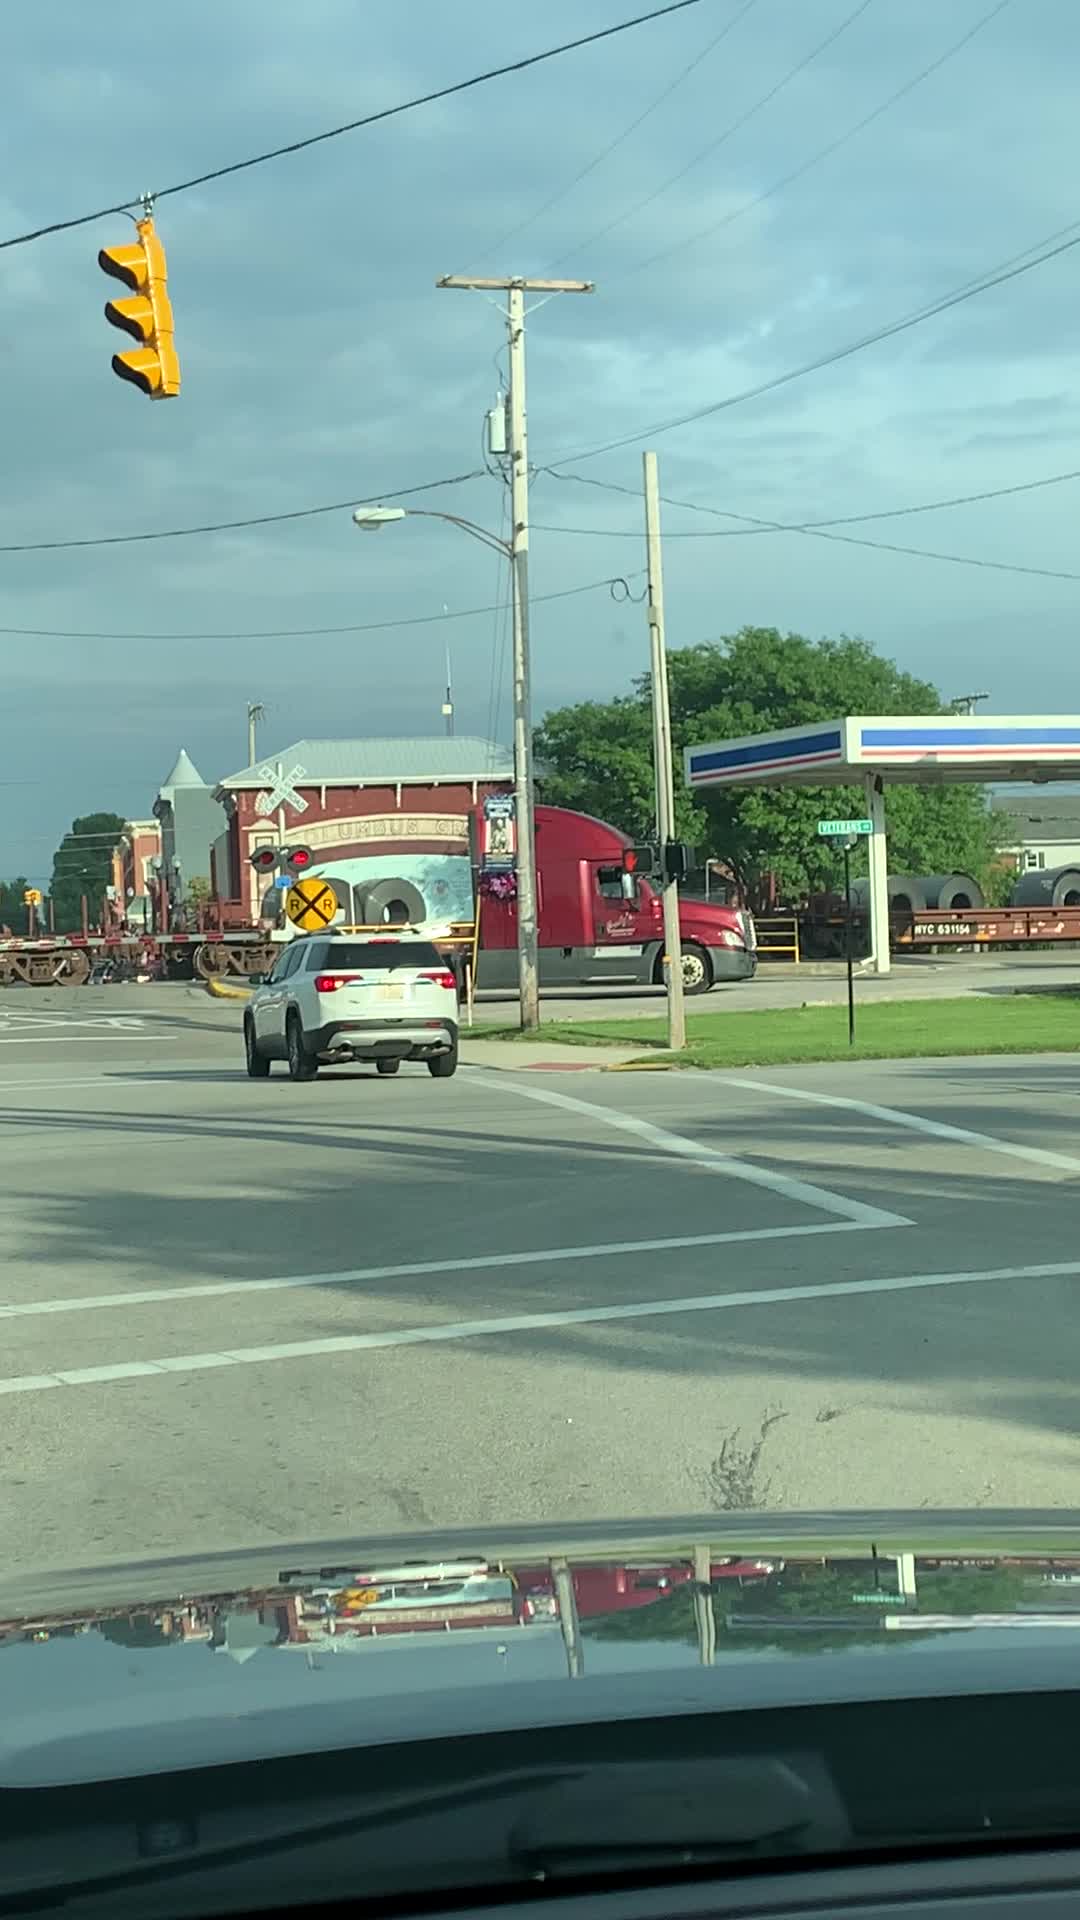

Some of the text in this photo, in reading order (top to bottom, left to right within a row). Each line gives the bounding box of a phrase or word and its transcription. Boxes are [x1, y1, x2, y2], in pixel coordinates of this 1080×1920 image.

[290, 898, 335, 911] R R
[914, 924, 935, 935] NYC
[937, 924, 969, 935] 631154
